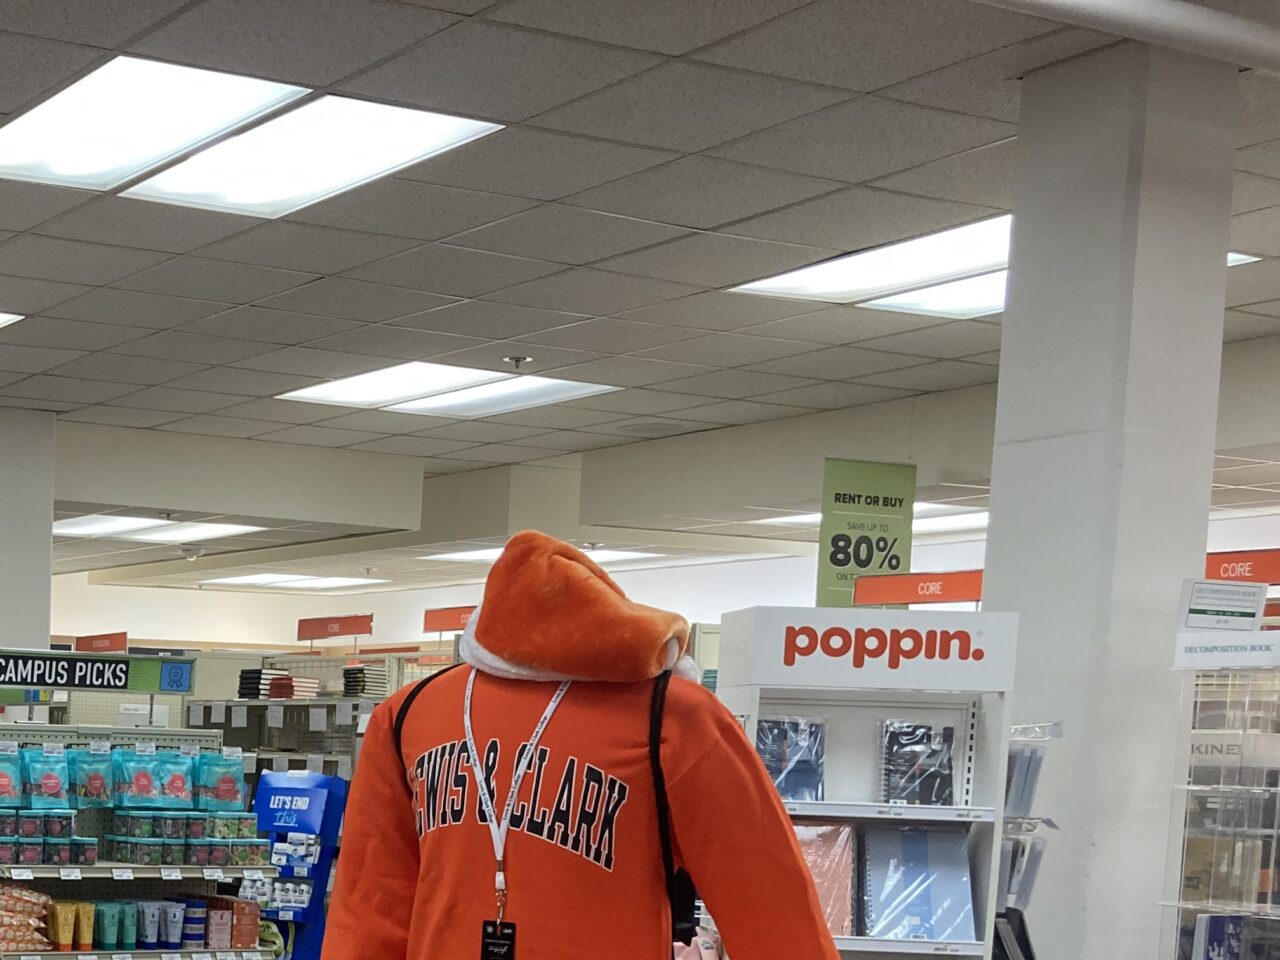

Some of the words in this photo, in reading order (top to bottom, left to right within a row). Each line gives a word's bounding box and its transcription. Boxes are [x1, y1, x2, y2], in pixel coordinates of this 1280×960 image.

[834, 492, 862, 505] RENT
[865, 496, 880, 506] OR
[883, 497, 904, 508] BUY
[847, 521, 866, 532] SAVE
[867, 523, 878, 532] UP
[879, 524, 889, 532] TO
[829, 533, 901, 571] 80%
[836, 572, 848, 581] ON
[1220, 562, 1254, 577] CORE
[918, 581, 943, 595] CORE
[74, 662, 127, 686] PICKS
[269, 795, 292, 809] LET'S
[292, 796, 310, 810] END
[508, 741, 629, 872] CLARK
